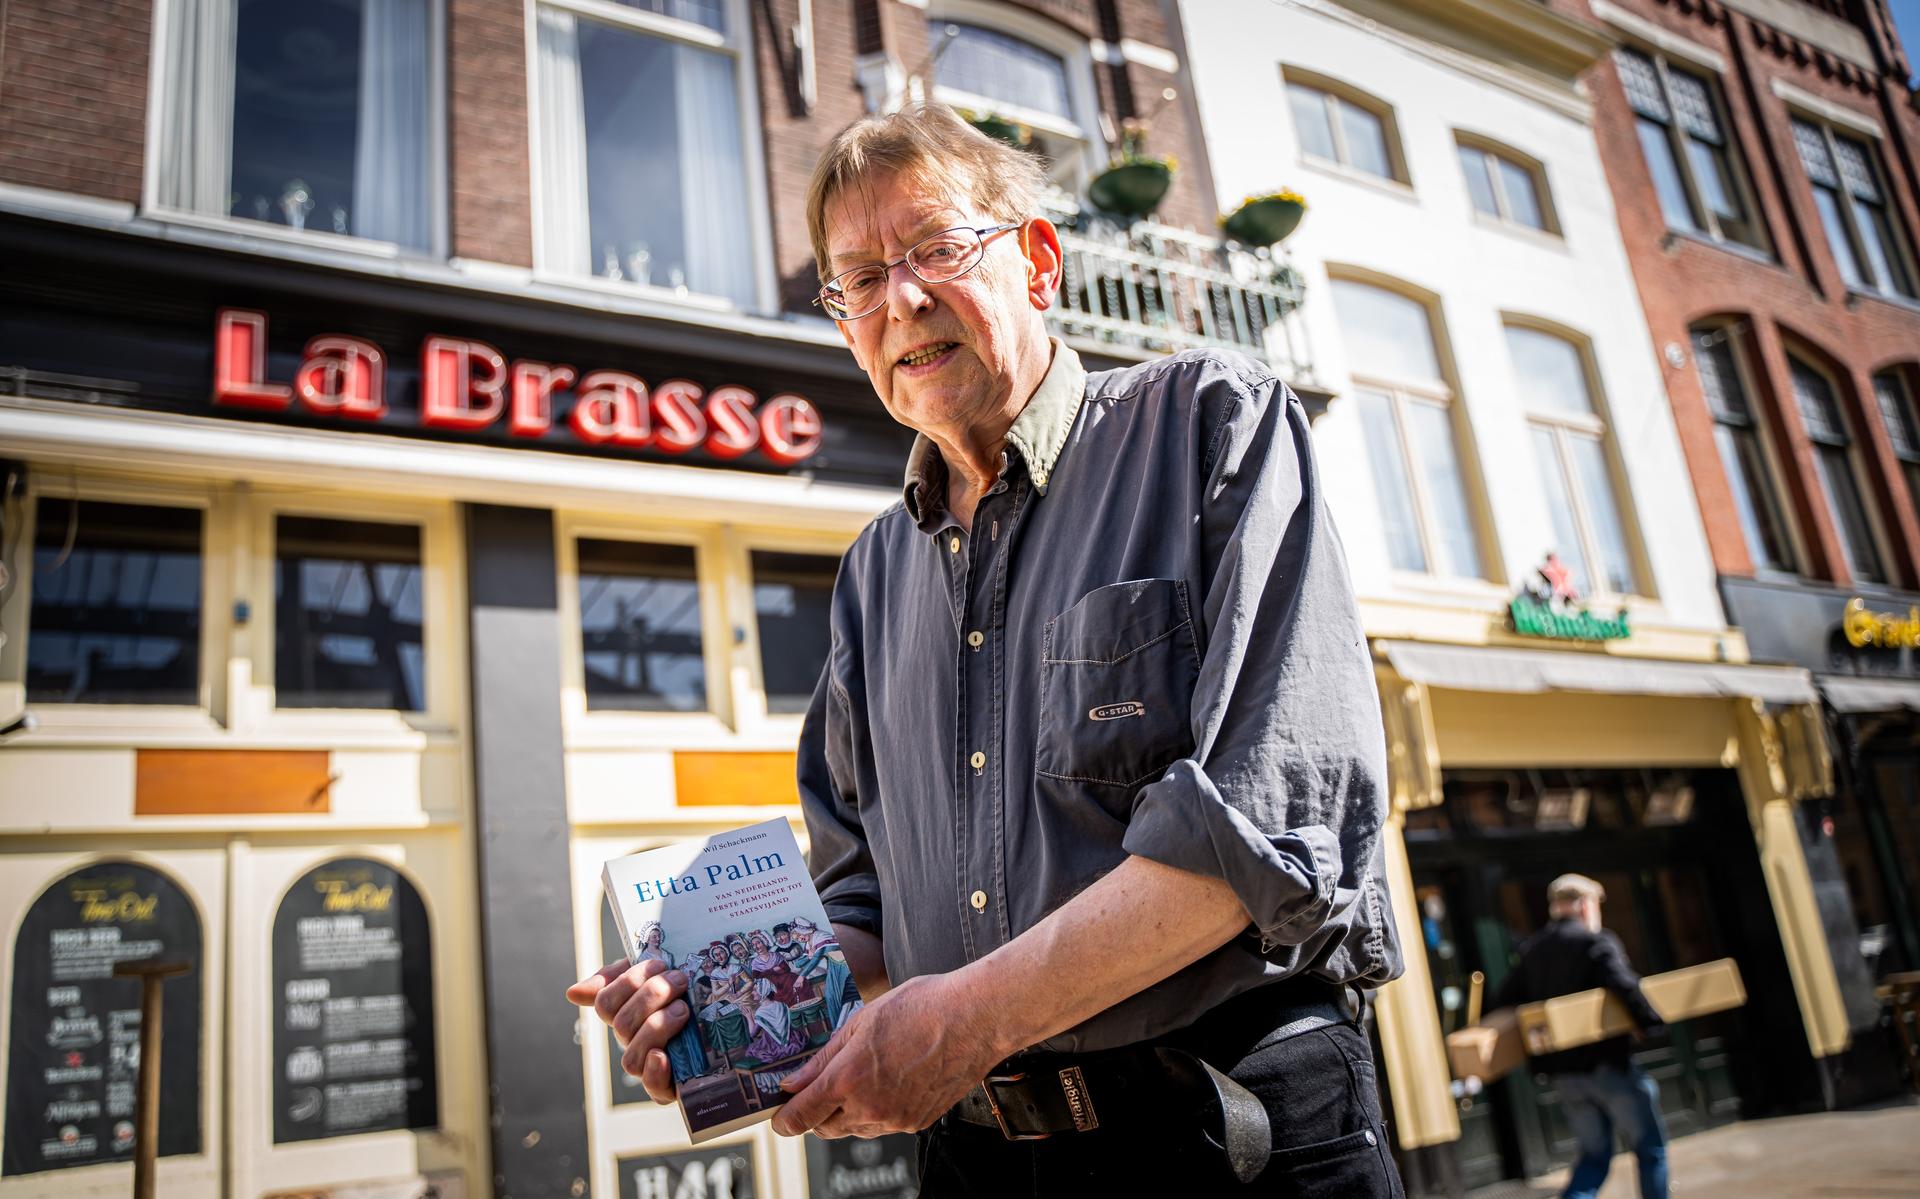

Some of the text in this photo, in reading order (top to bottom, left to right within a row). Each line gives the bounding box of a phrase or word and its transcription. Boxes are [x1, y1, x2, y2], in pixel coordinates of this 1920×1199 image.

[214, 309, 824, 466] La Brasse
[1098, 705, 1135, 717] G-STAR
[703, 832, 768, 854] Wil Schackmann
[633, 851, 786, 904] Etta Palm
[715, 875, 789, 901] VAN NEDERLANDS
[708, 881, 803, 913] EERSTE FEMINISTE TOT
[729, 896, 790, 919] STAATSVIJAND
[1060, 1070, 1089, 1130] Wrangler
